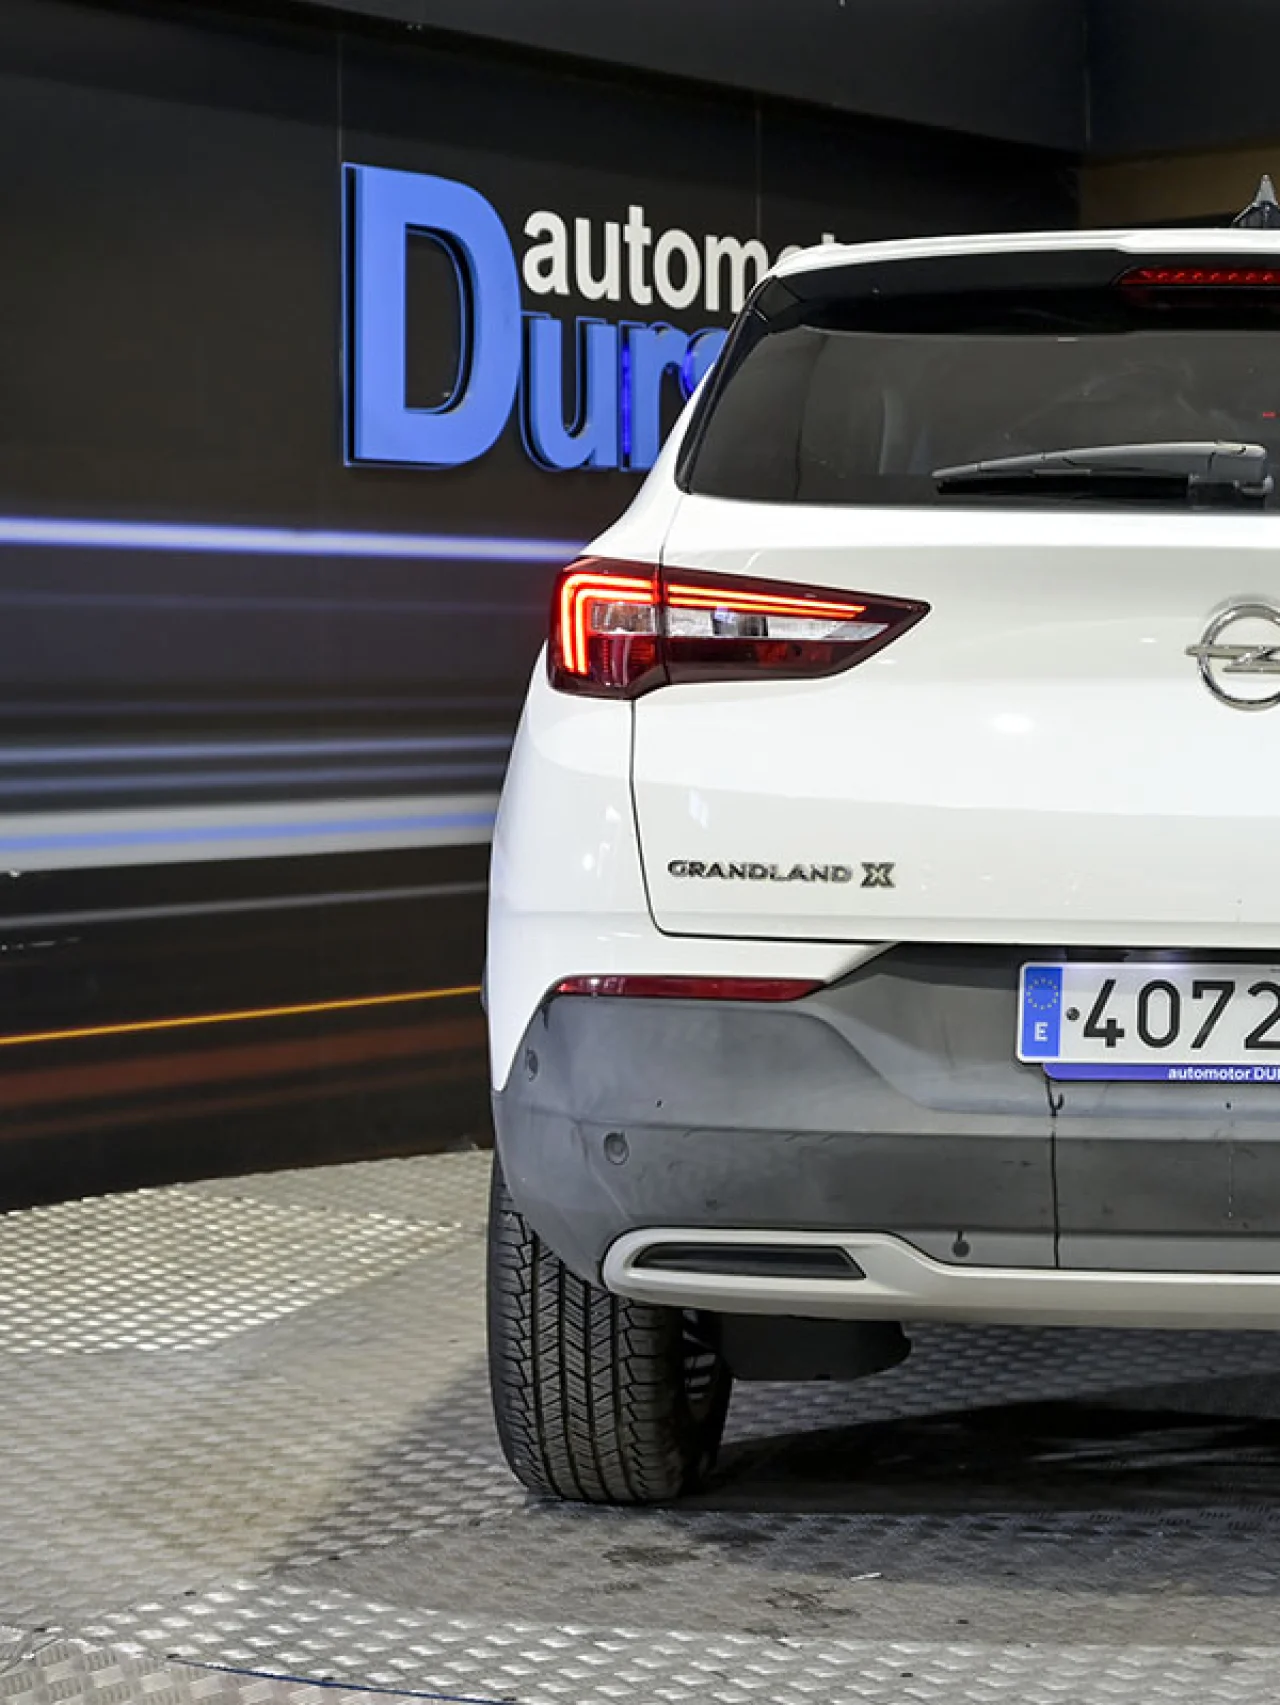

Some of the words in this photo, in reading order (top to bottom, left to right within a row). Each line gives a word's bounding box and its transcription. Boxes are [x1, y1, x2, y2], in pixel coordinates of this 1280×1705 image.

[667, 859, 854, 883] GRANDLAND
[860, 862, 896, 888] X
[1034, 1021, 1049, 1042] E
